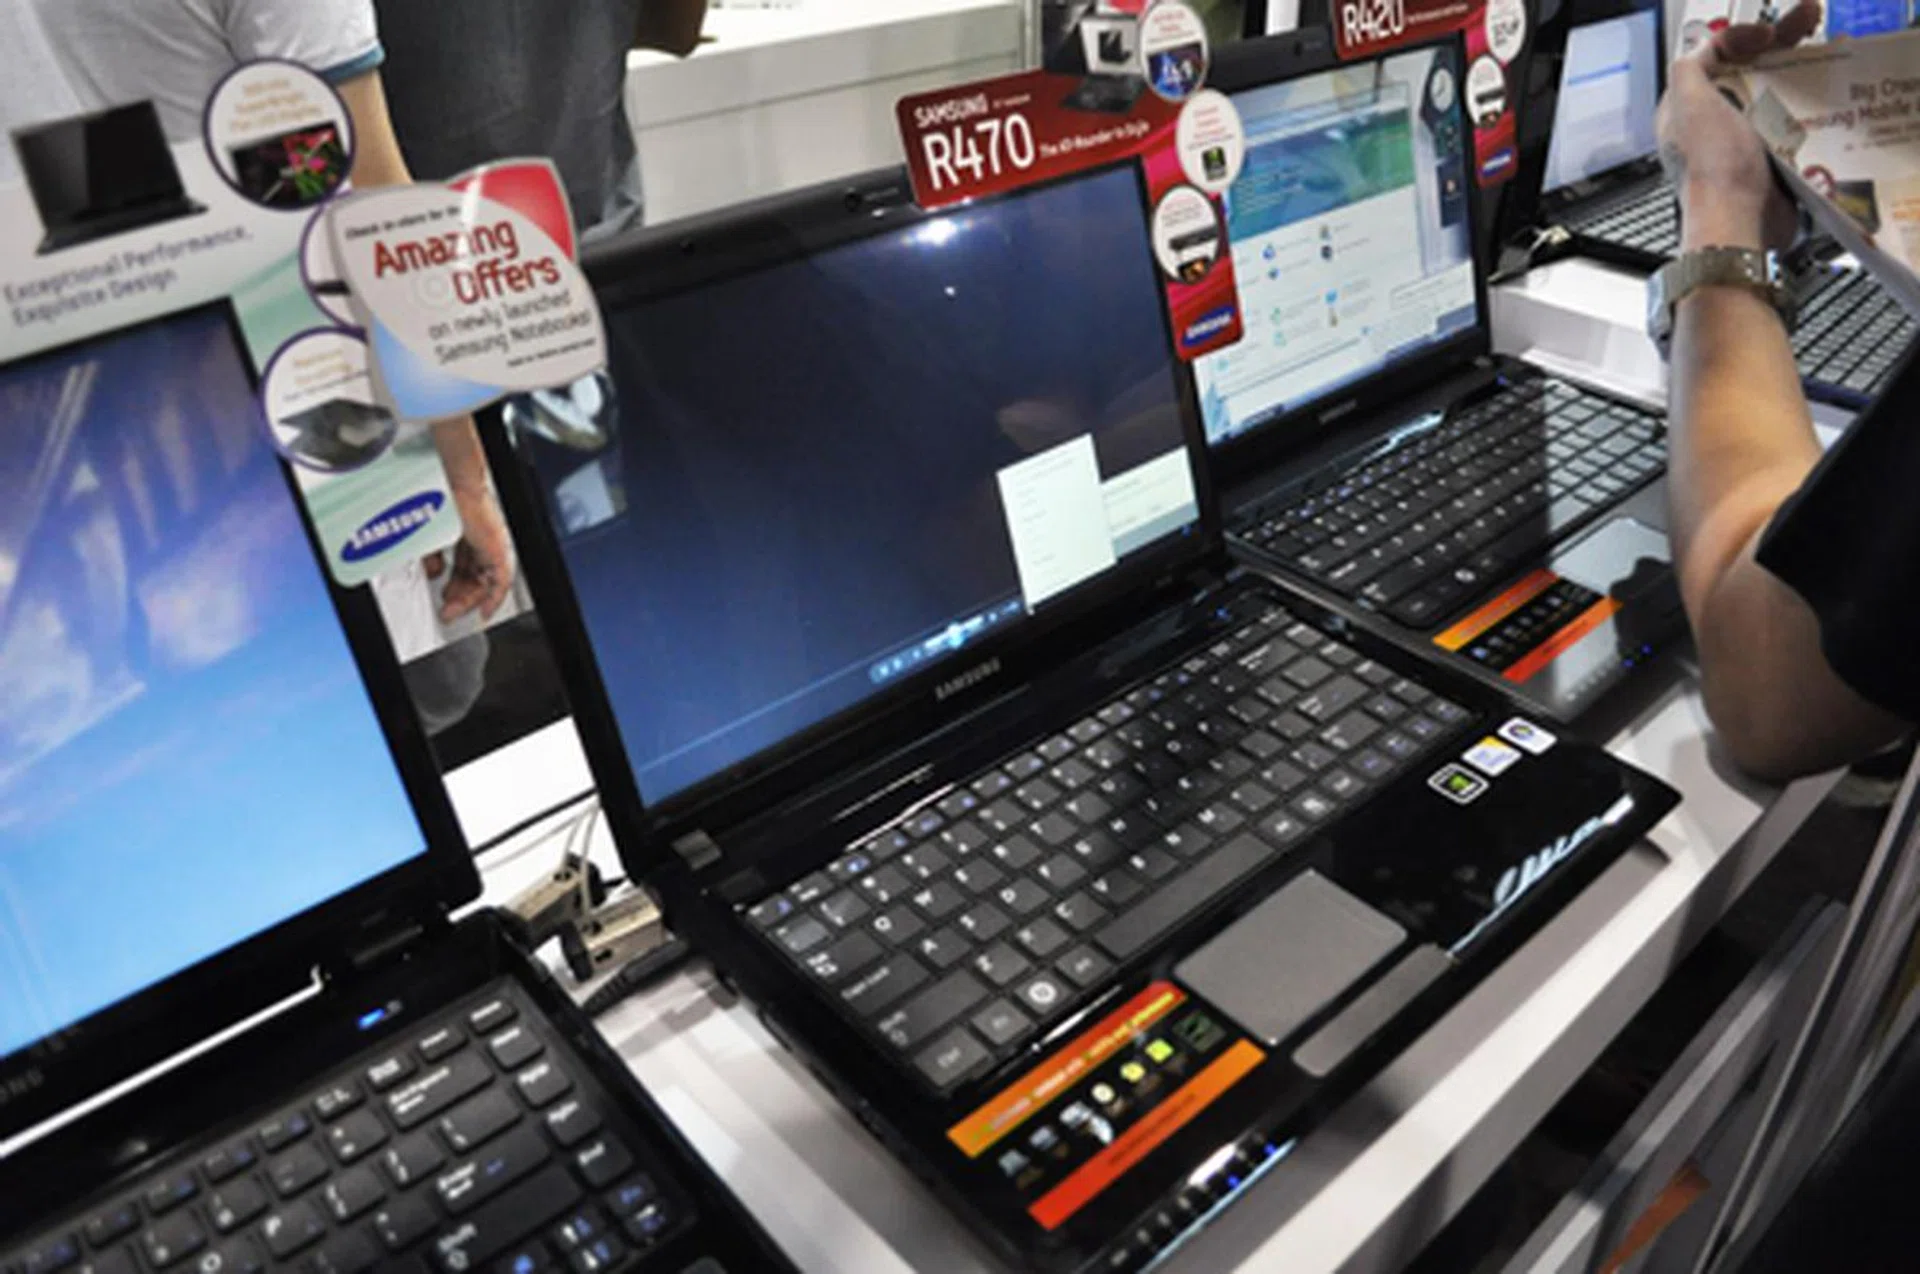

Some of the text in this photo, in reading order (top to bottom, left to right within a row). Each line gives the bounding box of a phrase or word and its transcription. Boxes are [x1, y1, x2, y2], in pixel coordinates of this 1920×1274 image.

[913, 92, 989, 129] SAMSUNG
[921, 113, 1036, 191] R470
[373, 219, 520, 280] Amazing
[3, 255, 122, 302] Exceptional
[11, 268, 178, 328] Exquisite Design
[451, 255, 561, 305] Offers
[428, 289, 572, 341] on newly launched
[433, 330, 510, 366] Samsung
[350, 501, 437, 550] SAMSUNG
